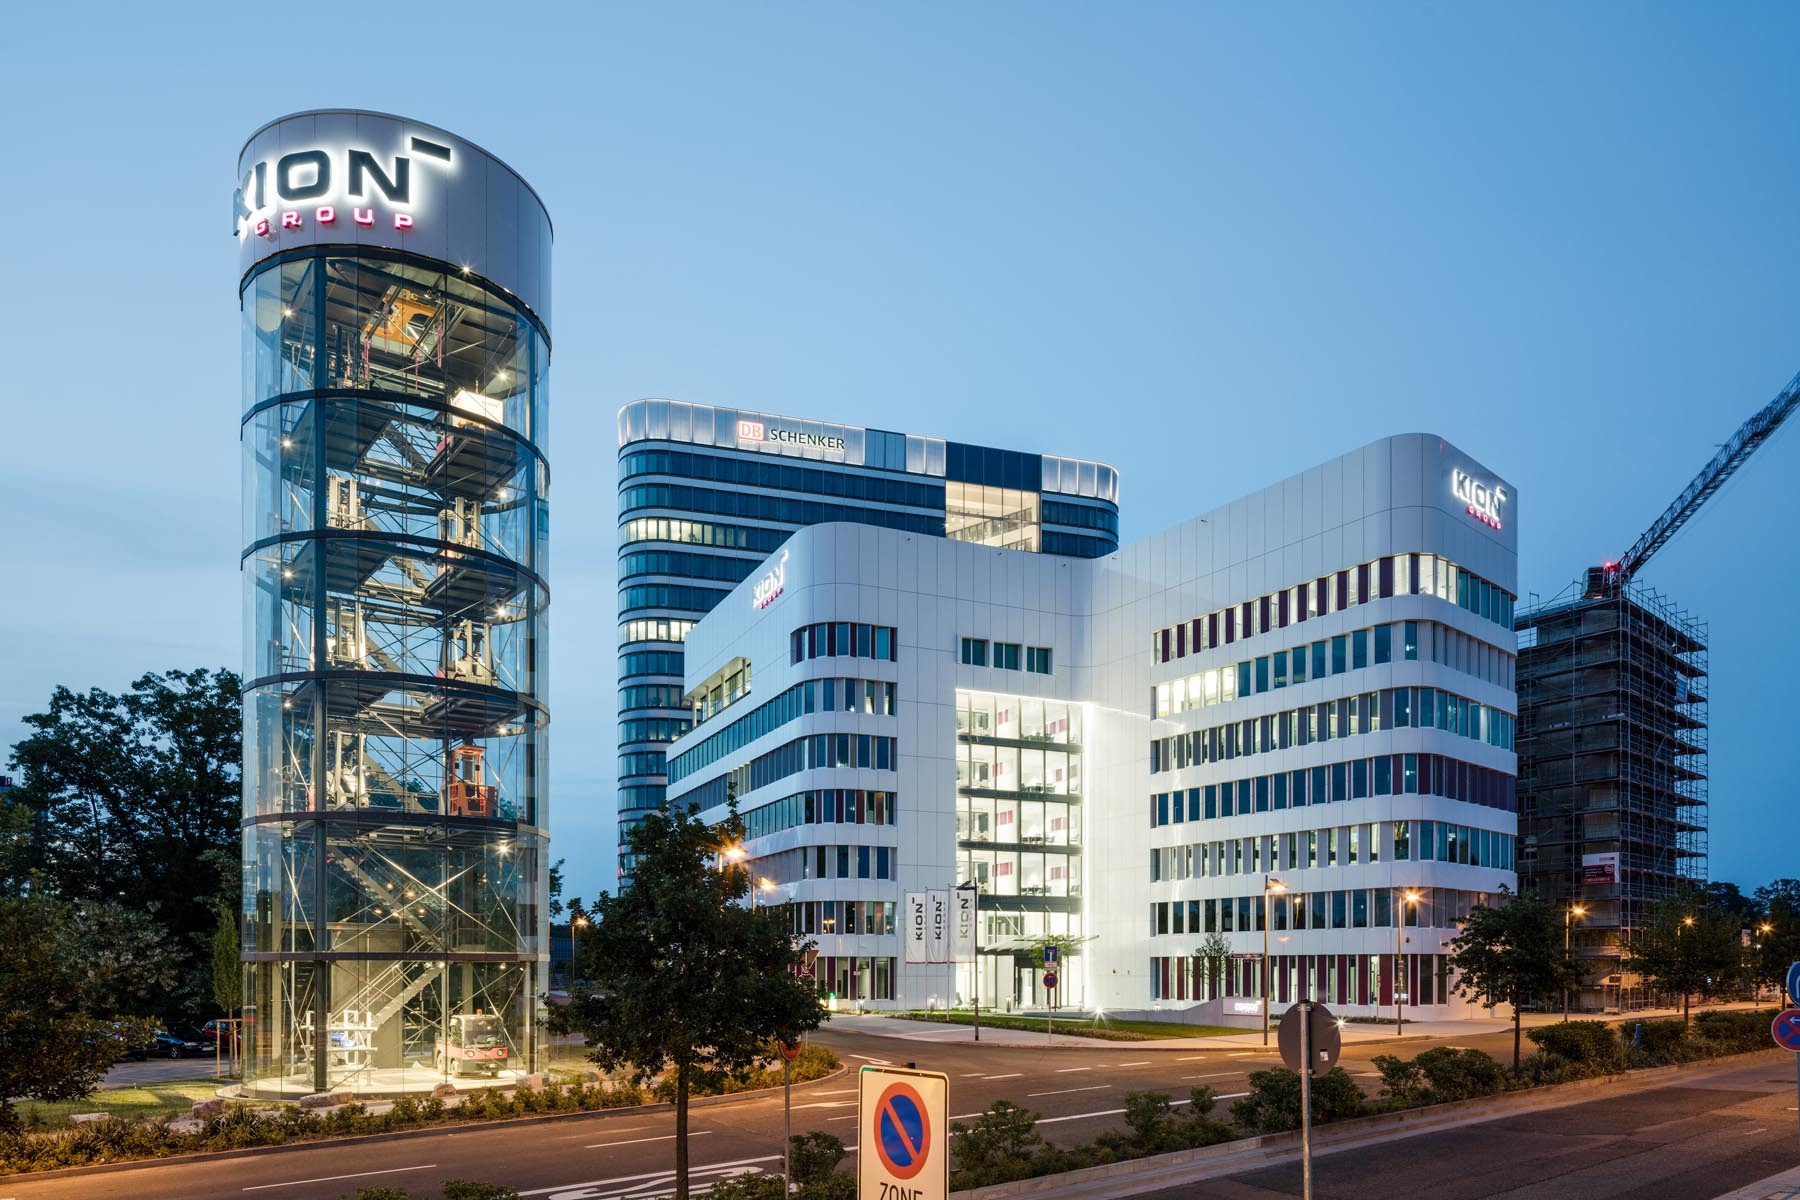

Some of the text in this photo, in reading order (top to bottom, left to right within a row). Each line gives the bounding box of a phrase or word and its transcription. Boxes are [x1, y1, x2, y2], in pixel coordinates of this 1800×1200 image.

[254, 206, 414, 237] GROUP
[741, 423, 845, 449] DB SCHENKER
[1454, 469, 1502, 520] KION
[915, 903, 924, 940] KION
[960, 898, 969, 938] KION
